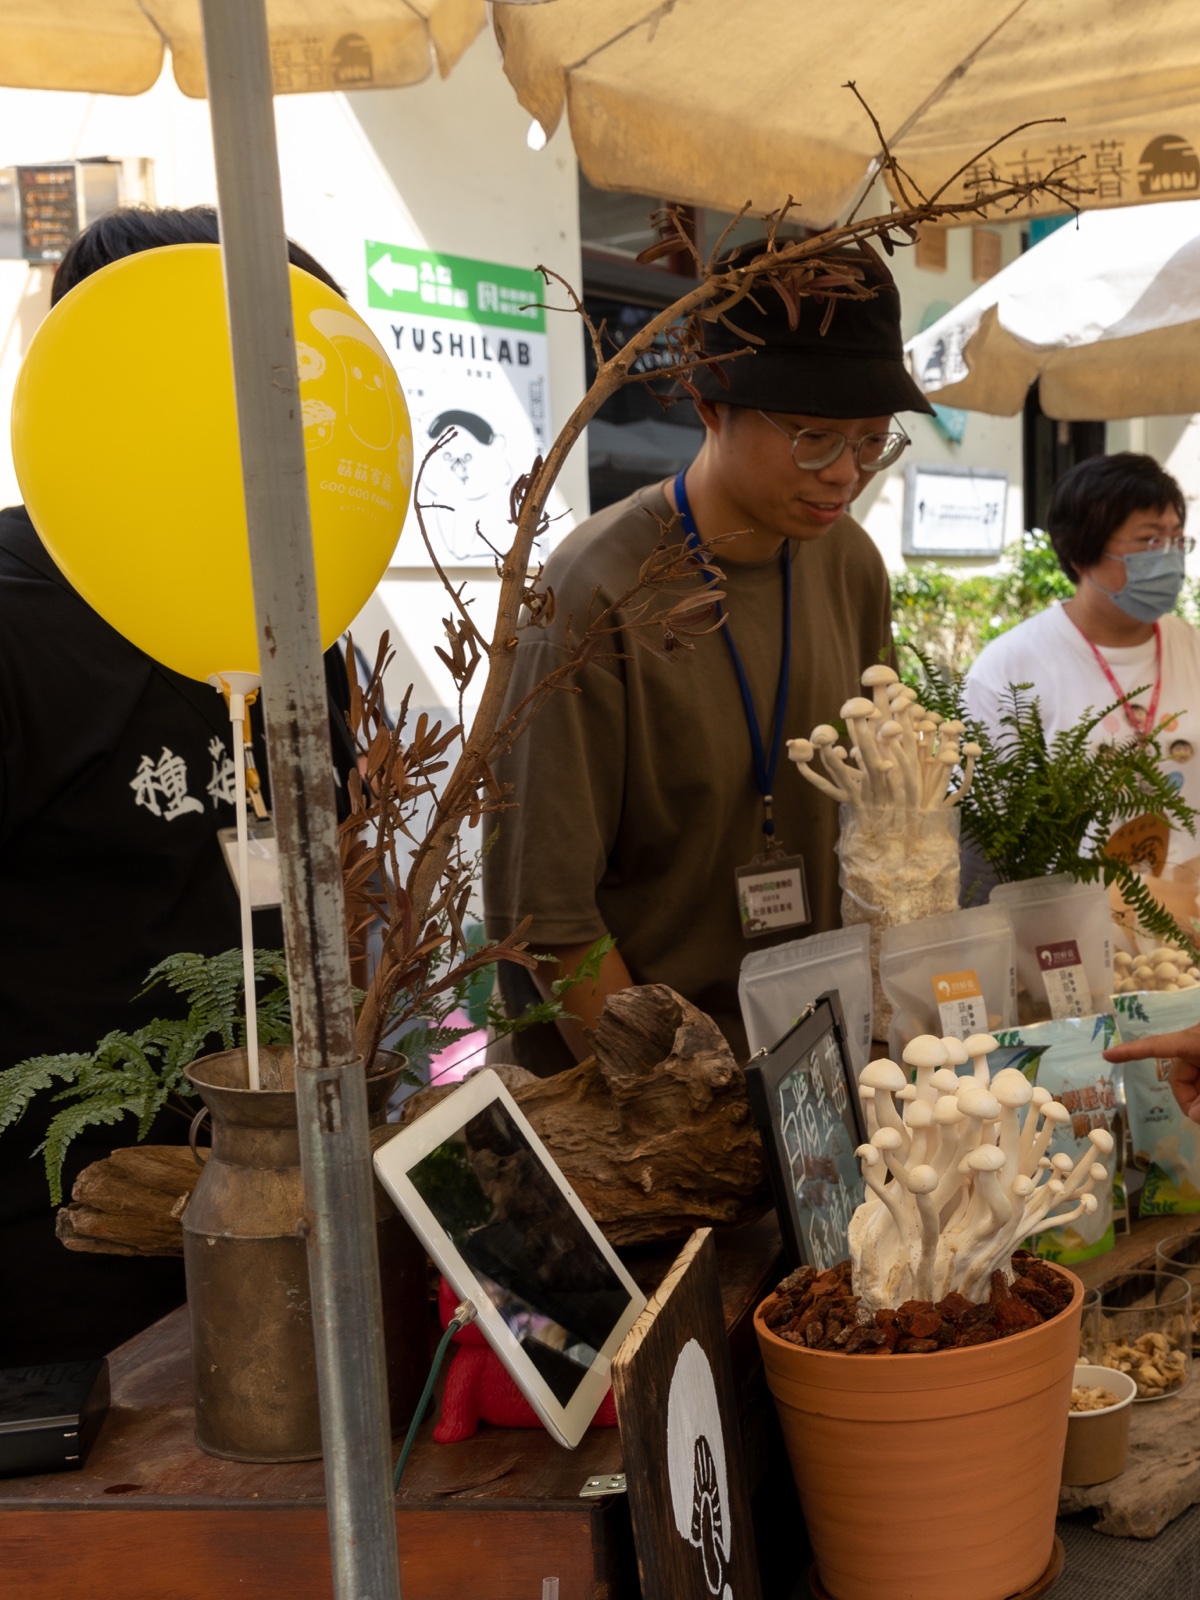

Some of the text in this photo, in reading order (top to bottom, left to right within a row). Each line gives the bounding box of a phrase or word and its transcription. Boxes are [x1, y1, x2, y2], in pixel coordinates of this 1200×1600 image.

[391, 324, 531, 366] YUSHILAB
[320, 480, 346, 494] GOO
[347, 486, 370, 501] GOO
[371, 493, 395, 512] FAMILY
